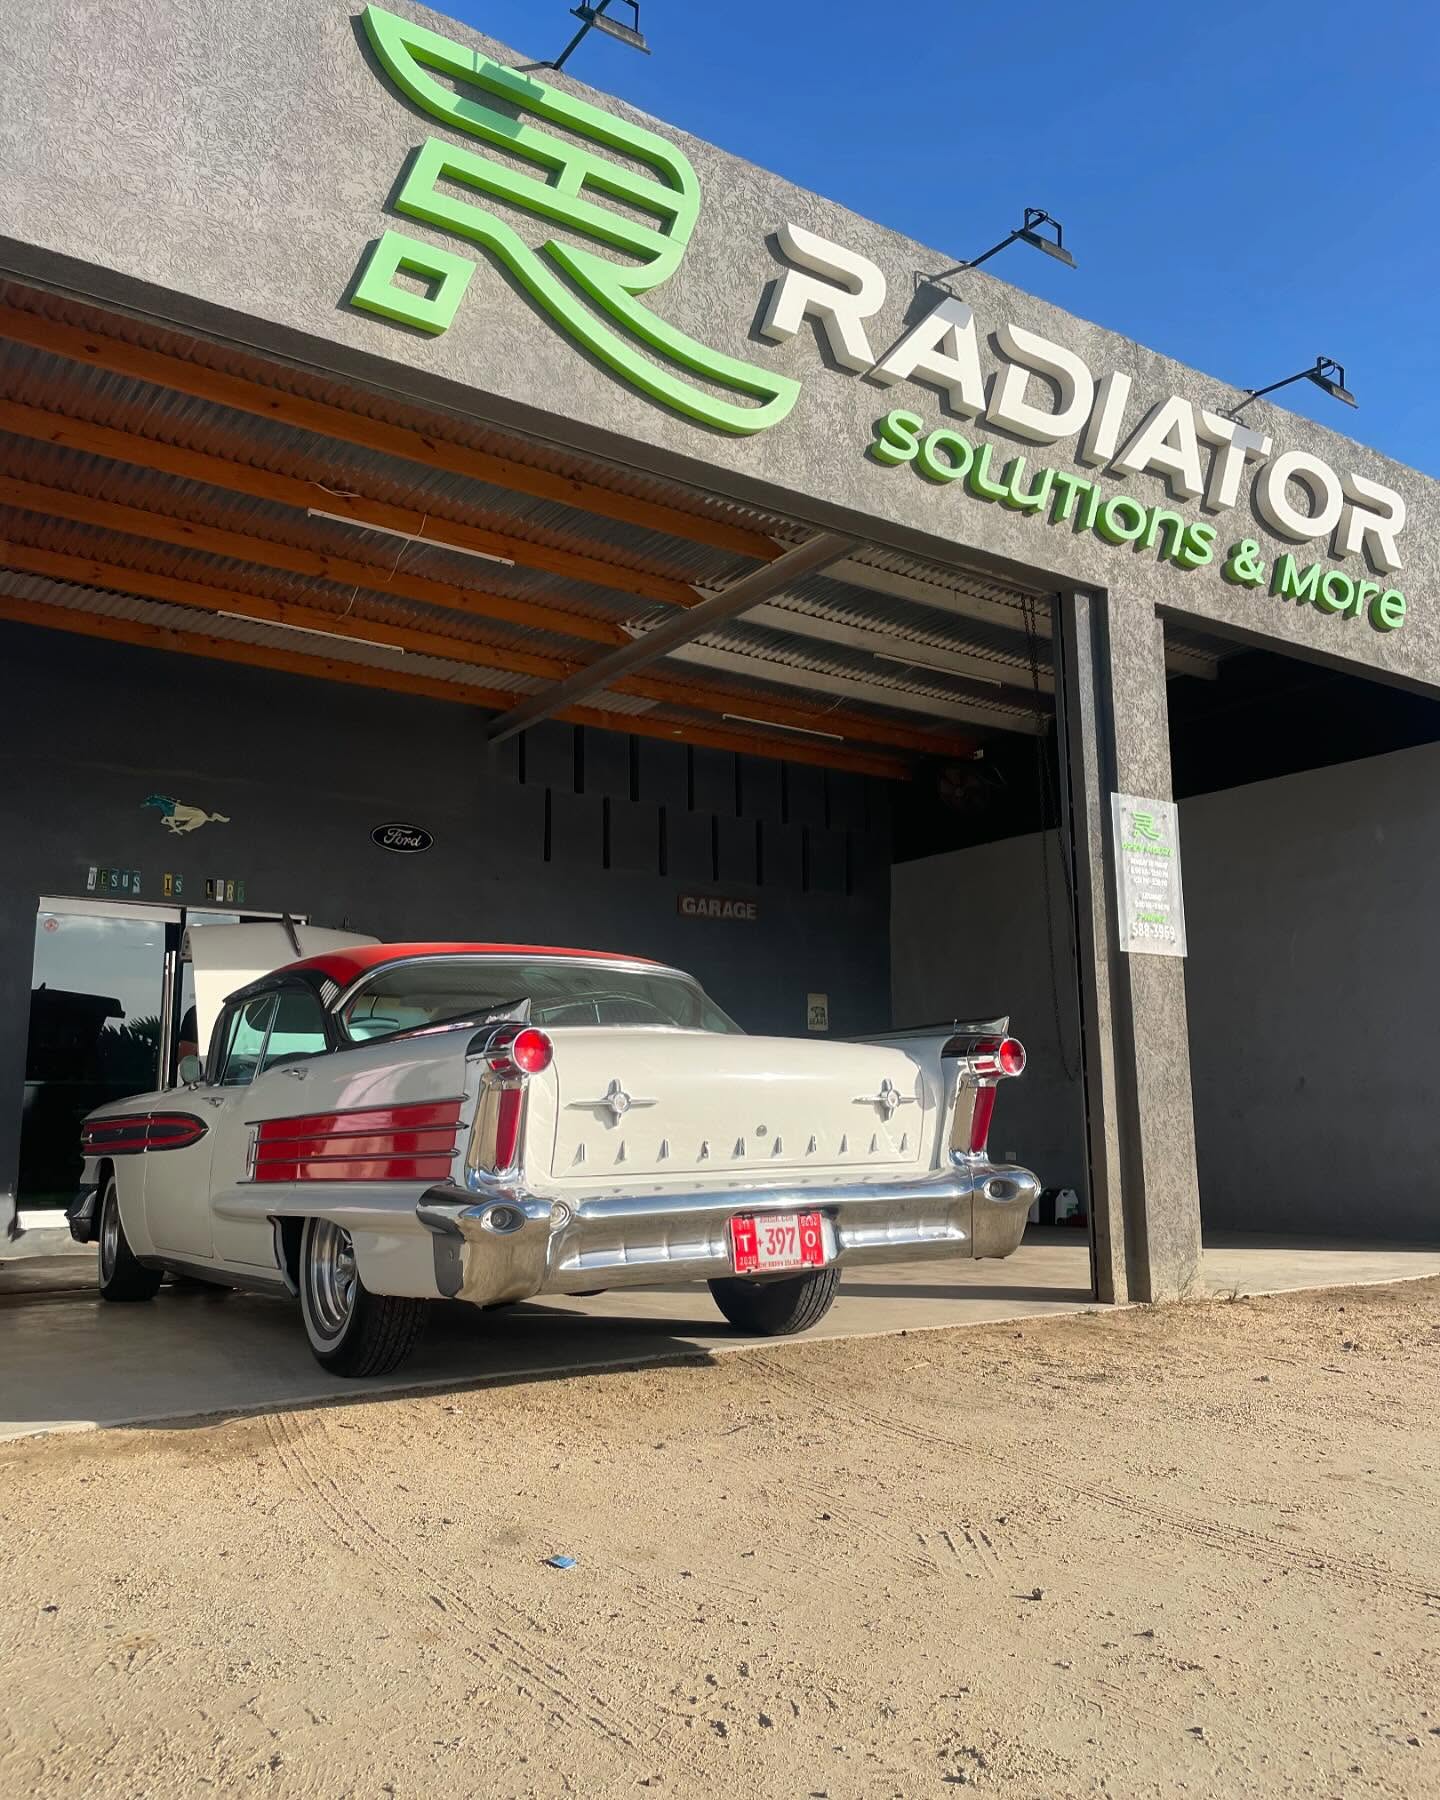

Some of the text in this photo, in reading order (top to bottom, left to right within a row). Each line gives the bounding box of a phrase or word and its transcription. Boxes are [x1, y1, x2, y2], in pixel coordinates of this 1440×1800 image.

[760, 222, 1405, 573] RADIATOR
[1224, 538, 1266, 587] &
[383, 827, 422, 847] Ford
[88, 868, 141, 892] JESUS
[164, 876, 184, 895] IS
[682, 897, 757, 920] GARAGE
[740, 1234, 751, 1252] T
[765, 1227, 796, 1256] 397
